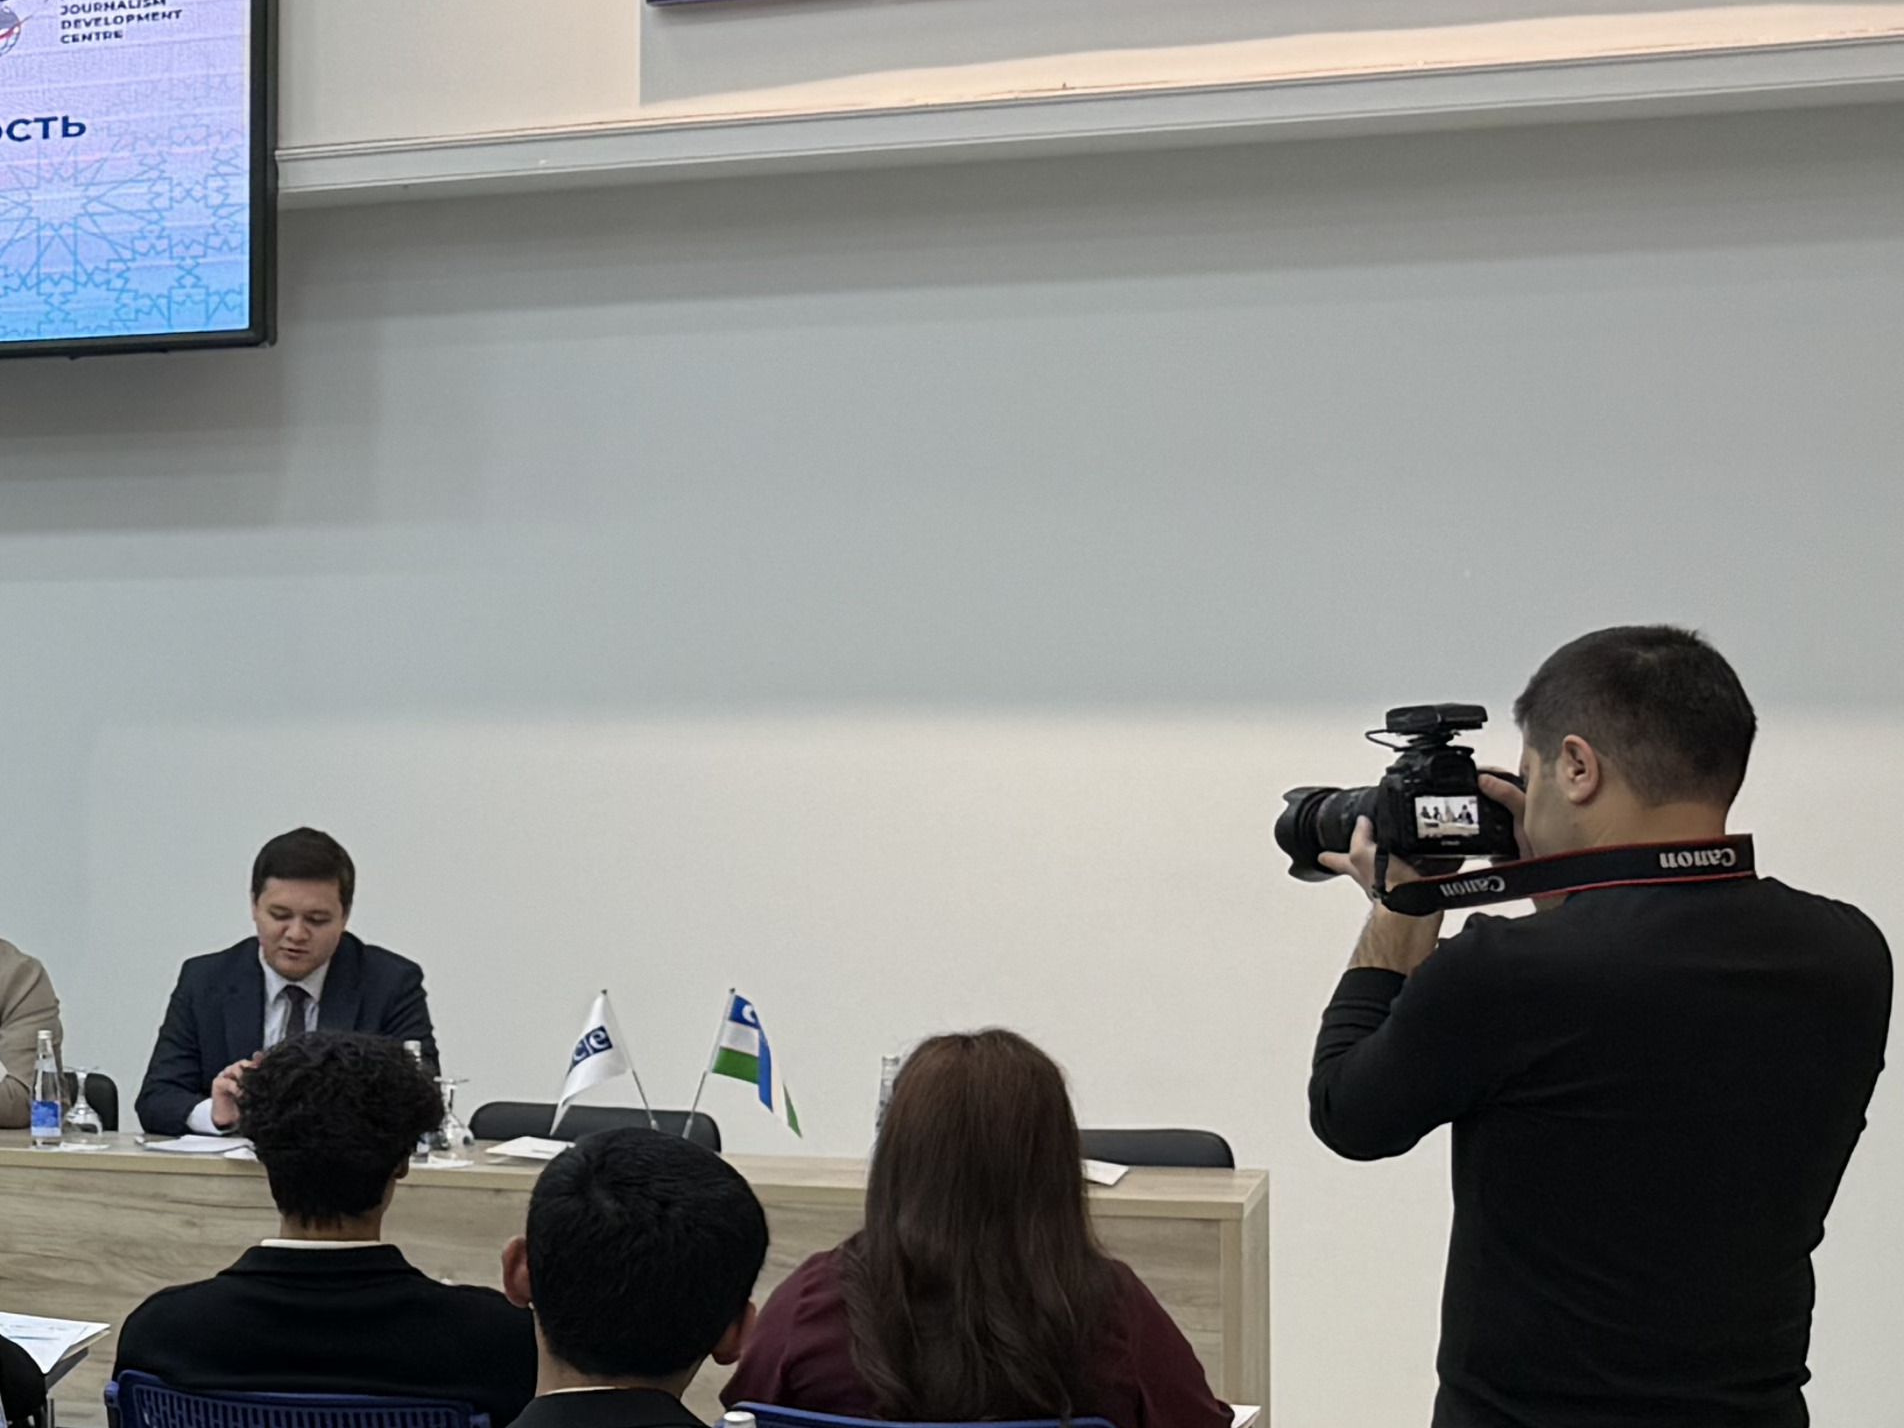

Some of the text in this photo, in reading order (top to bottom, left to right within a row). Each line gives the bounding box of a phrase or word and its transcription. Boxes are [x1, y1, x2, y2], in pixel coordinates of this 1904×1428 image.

[59, 9, 183, 31] DEVELOPMENT
[1659, 847, 1737, 869] Canon
[1439, 875, 1506, 898] Canon
